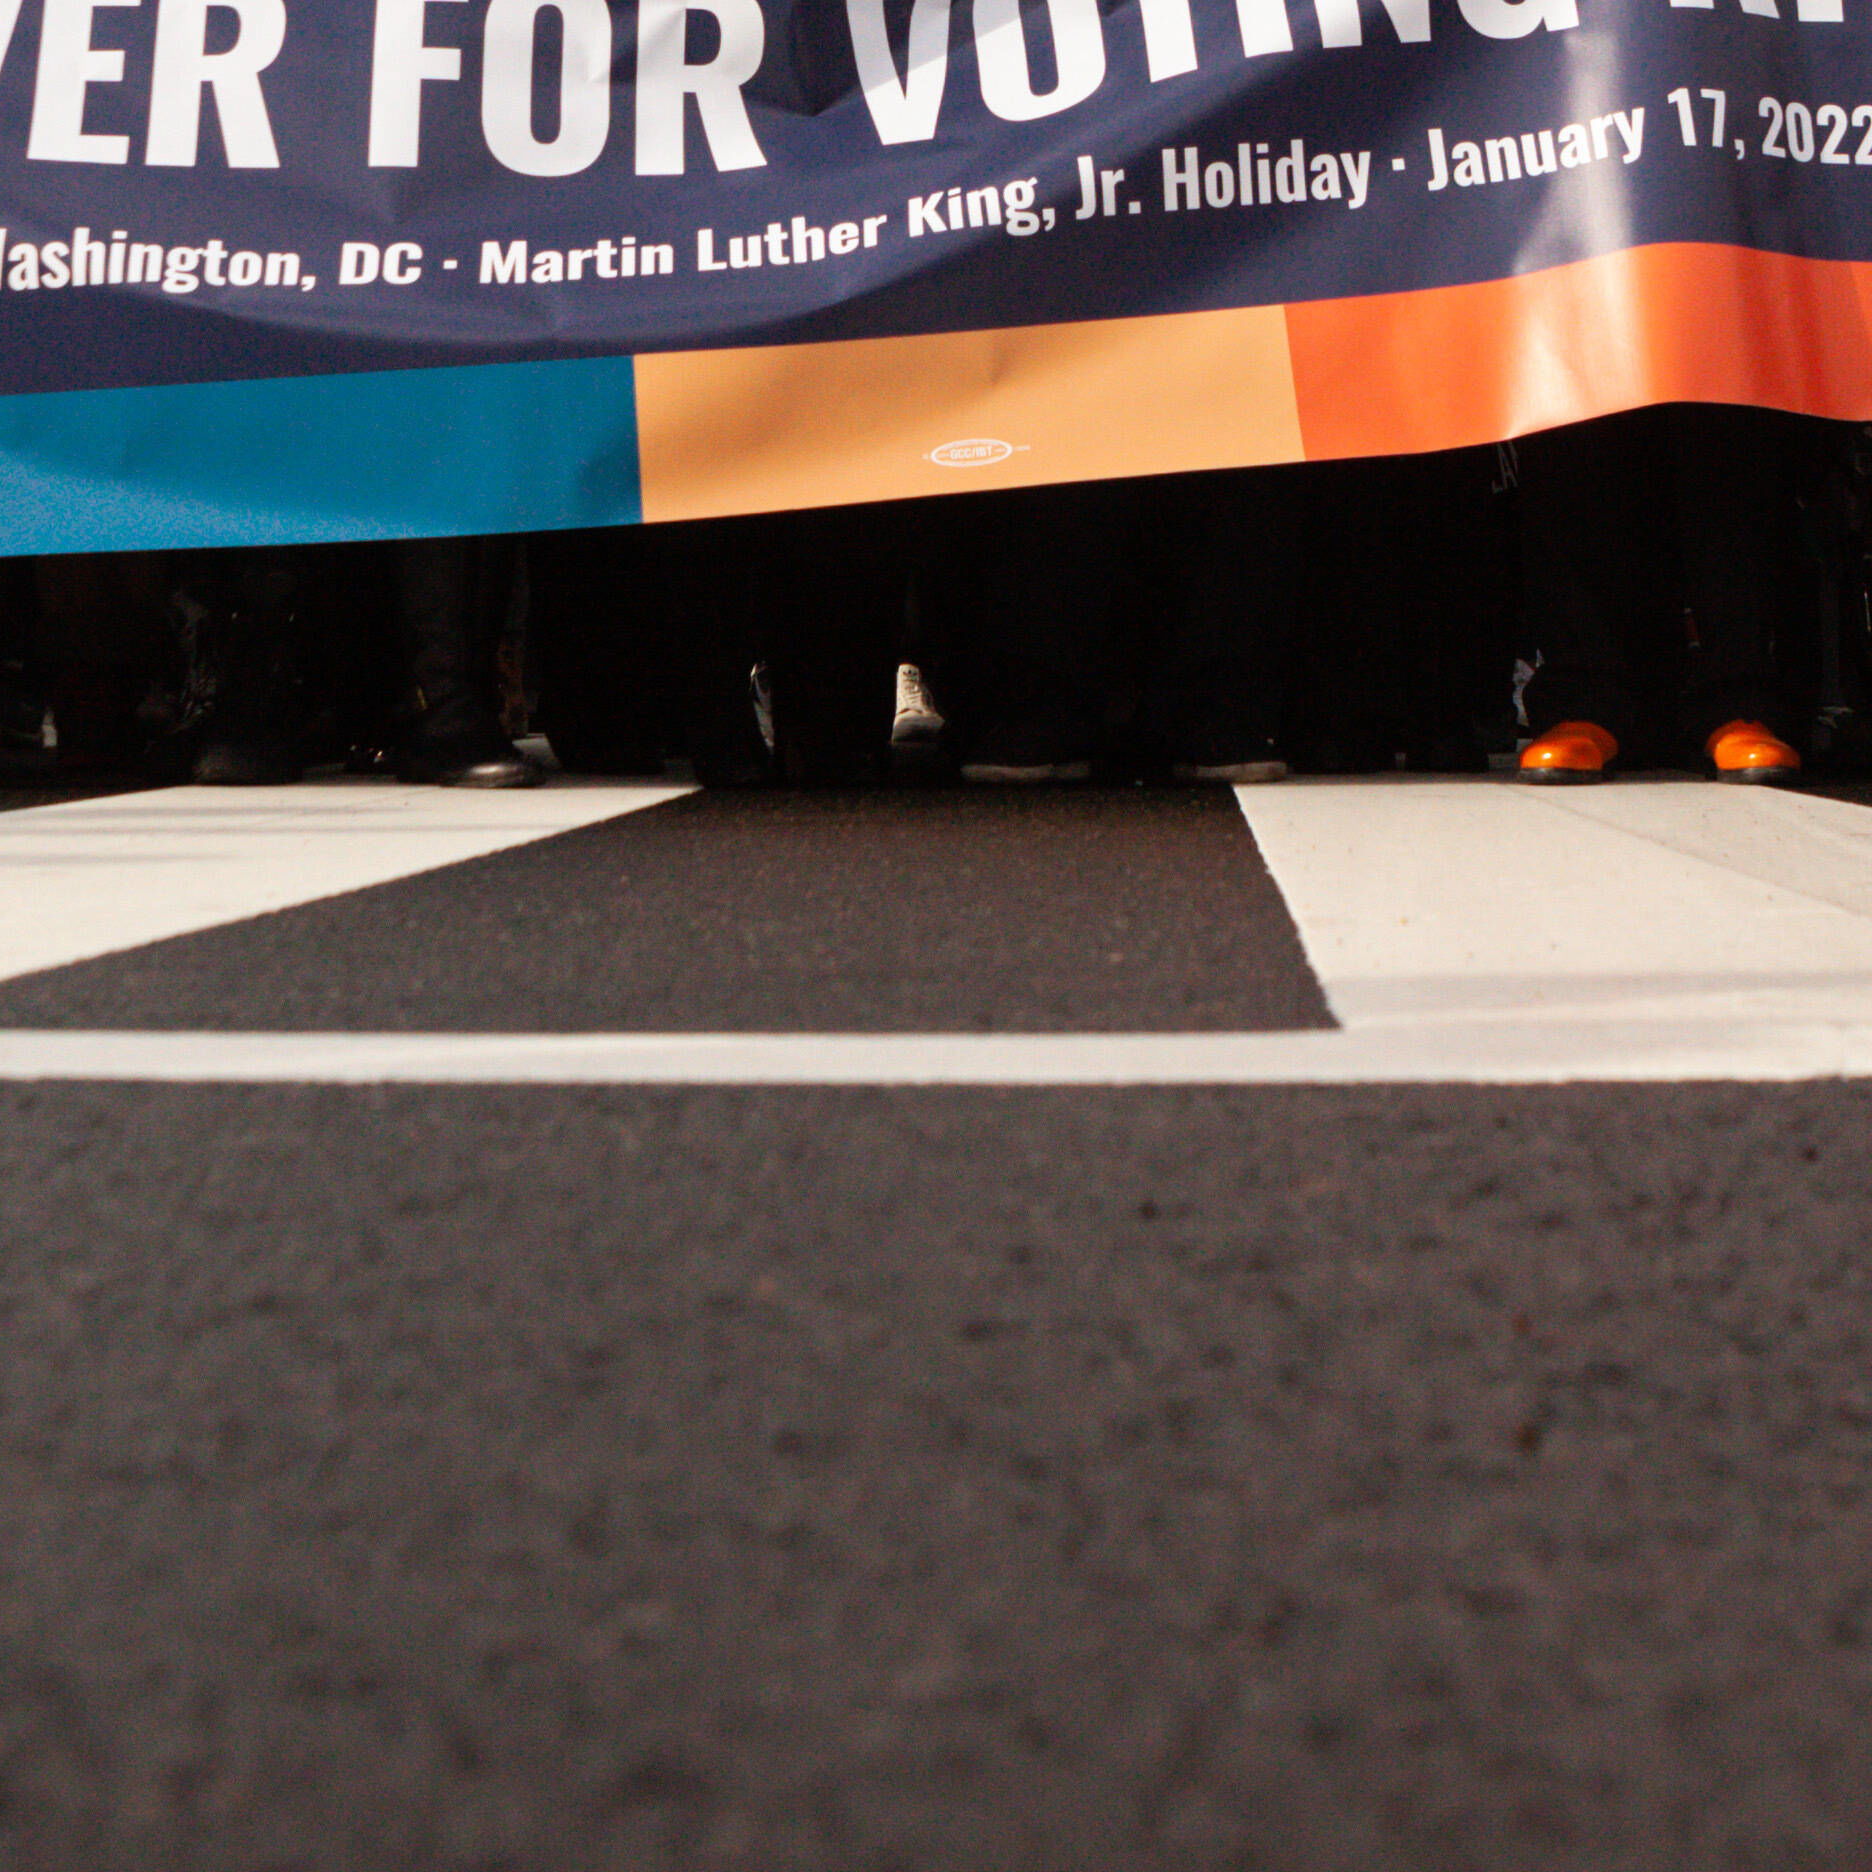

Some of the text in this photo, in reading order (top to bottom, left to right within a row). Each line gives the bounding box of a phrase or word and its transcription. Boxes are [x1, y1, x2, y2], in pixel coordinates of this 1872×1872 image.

[339, 242, 423, 285] DC
[479, 236, 675, 284] Martin
[697, 214, 887, 272] Luther
[908, 177, 1055, 238] King,
[1076, 155, 1141, 220] Jr.
[1162, 138, 1371, 211] Holiday
[1427, 106, 1646, 191] January
[1667, 87, 1746, 160] 17,
